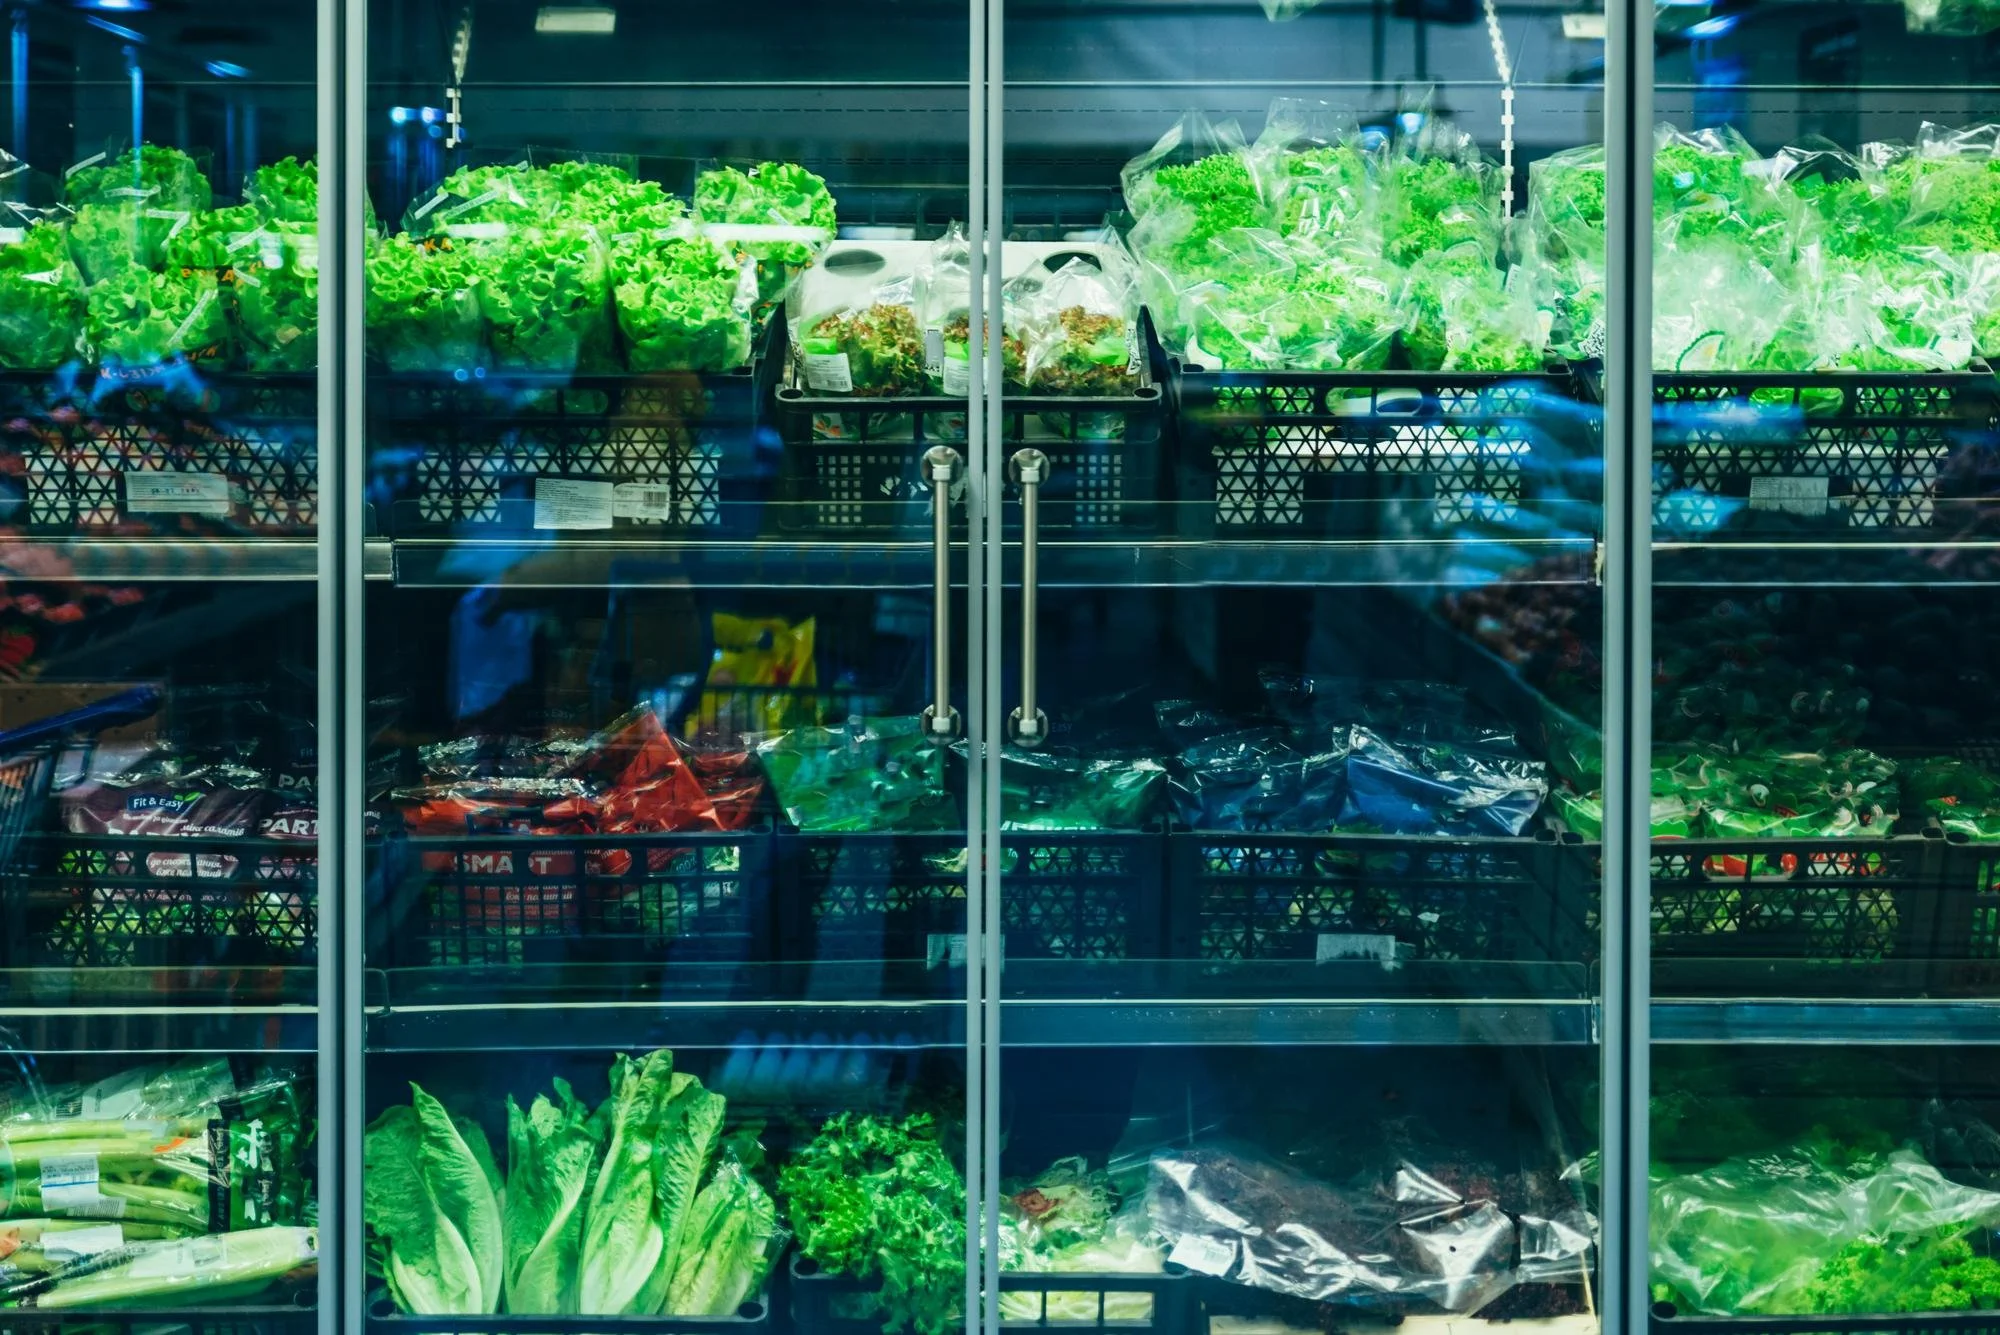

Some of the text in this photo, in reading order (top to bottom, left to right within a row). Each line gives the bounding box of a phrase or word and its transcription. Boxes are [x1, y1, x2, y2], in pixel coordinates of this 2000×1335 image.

[279, 774, 319, 790] PA
[133, 798, 184, 811] Fit & Easy
[453, 854, 552, 874] SMAT
